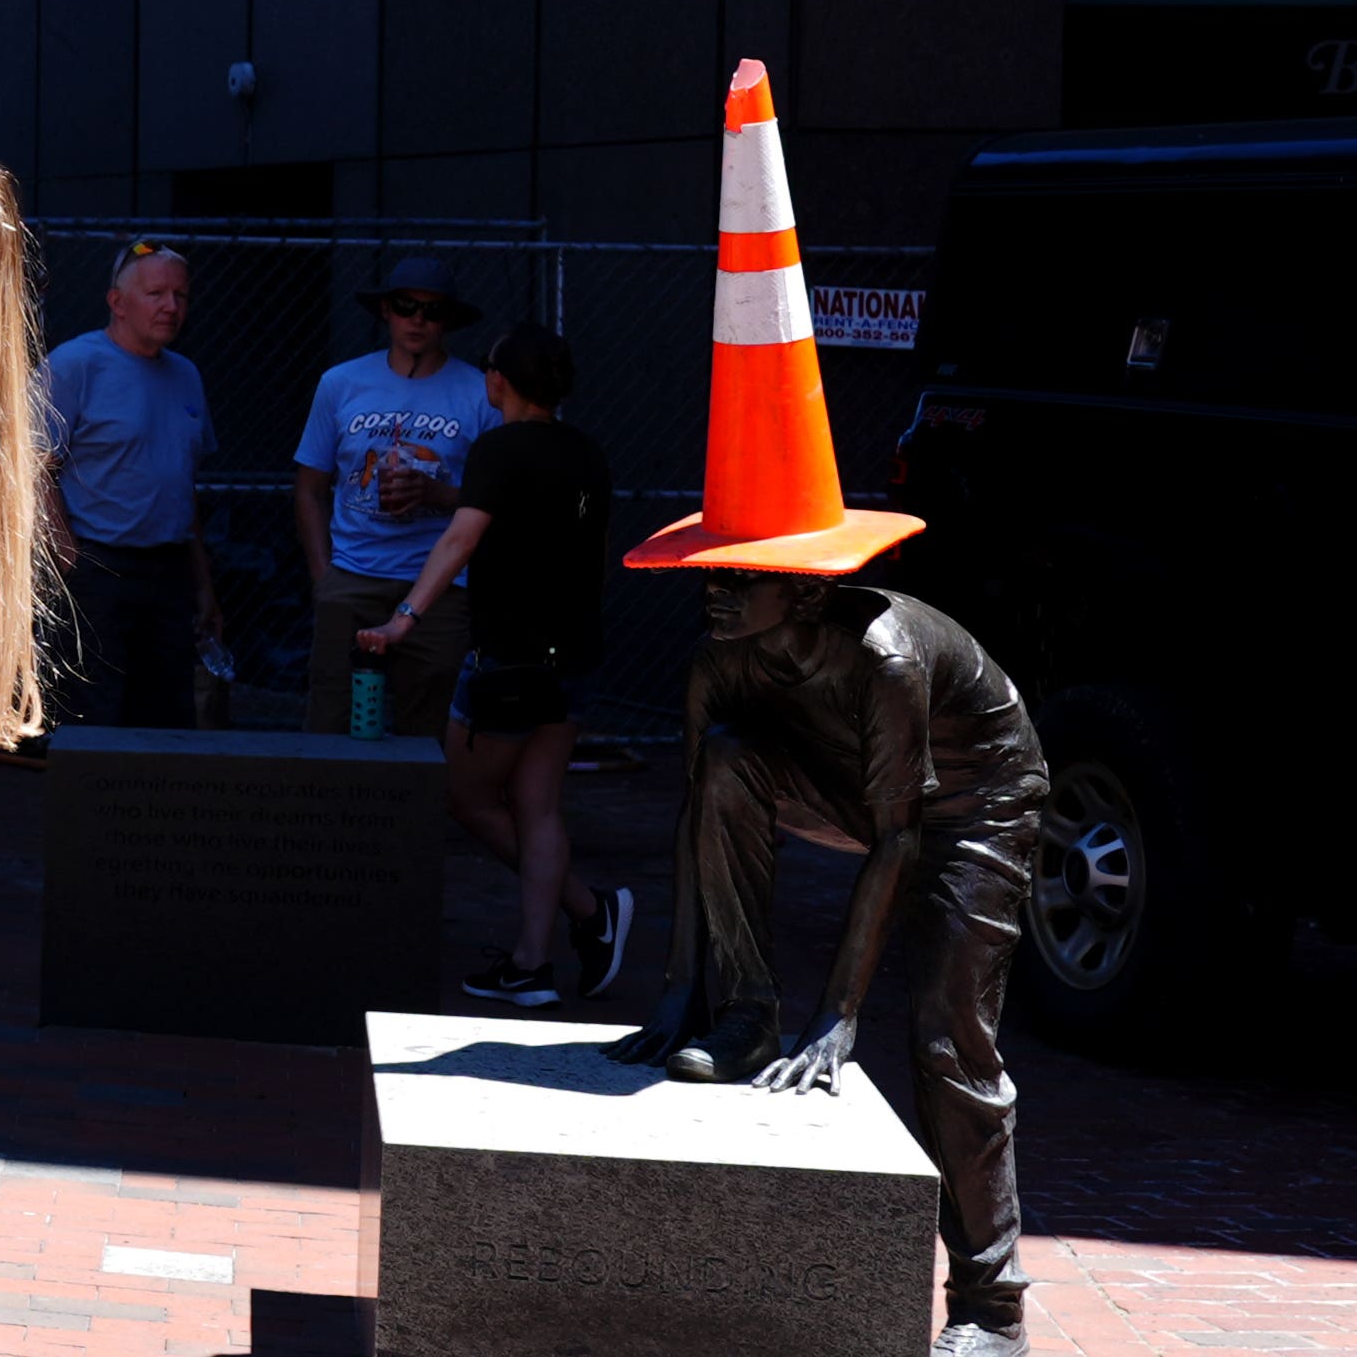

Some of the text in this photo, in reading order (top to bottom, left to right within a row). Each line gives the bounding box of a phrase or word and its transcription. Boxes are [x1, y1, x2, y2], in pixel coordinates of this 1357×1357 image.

[349, 411, 461, 438] COZY DOG
[418, 430, 437, 440] IN
[94, 801, 143, 822] who
[147, 803, 185, 822] live
[172, 830, 224, 850] who
[228, 832, 269, 852] live
[88, 855, 195, 879] egretting
[114, 880, 162, 907] they
